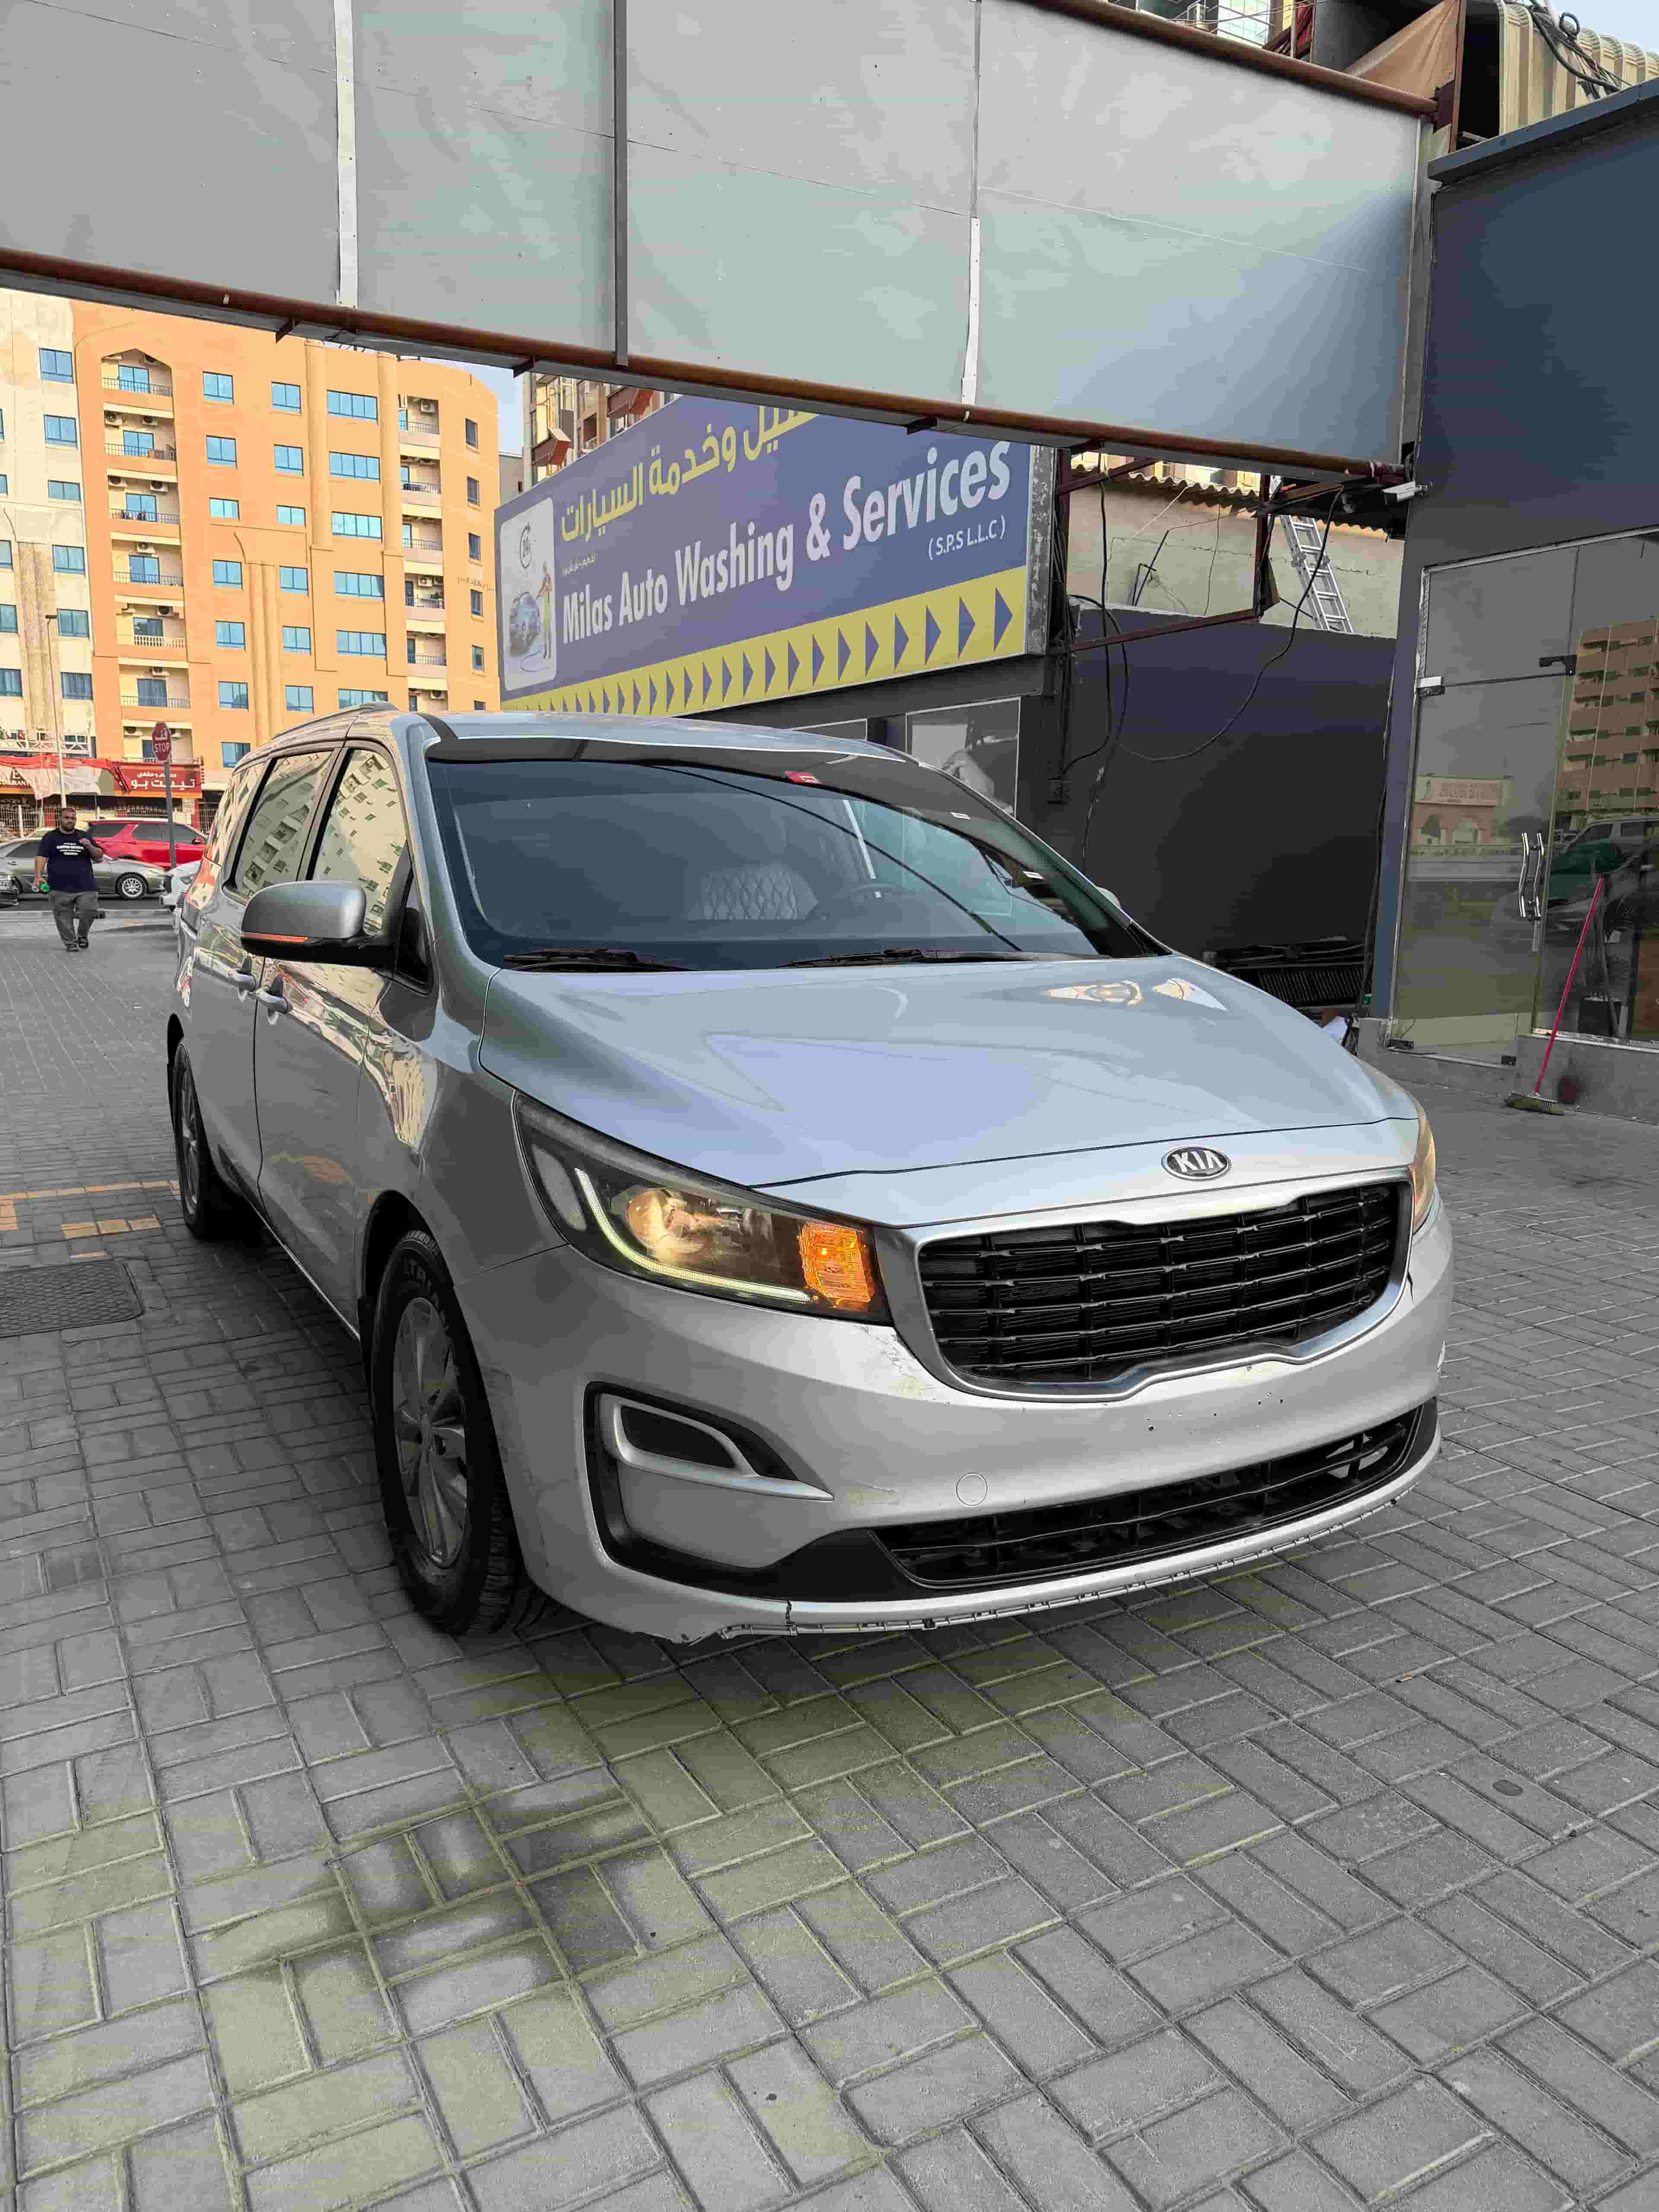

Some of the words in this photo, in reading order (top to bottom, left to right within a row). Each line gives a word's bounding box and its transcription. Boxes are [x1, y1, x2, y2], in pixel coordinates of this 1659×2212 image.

[649, 421, 736, 495] وخدمة
[561, 461, 643, 543] السيارات
[563, 584, 611, 644] Milas
[619, 569, 667, 626] Auto
[675, 522, 794, 605] Washing
[806, 493, 831, 561] &
[843, 441, 1011, 550] Services
[155, 743, 170, 753] STOP
[1171, 1150, 1226, 1173] KIA
